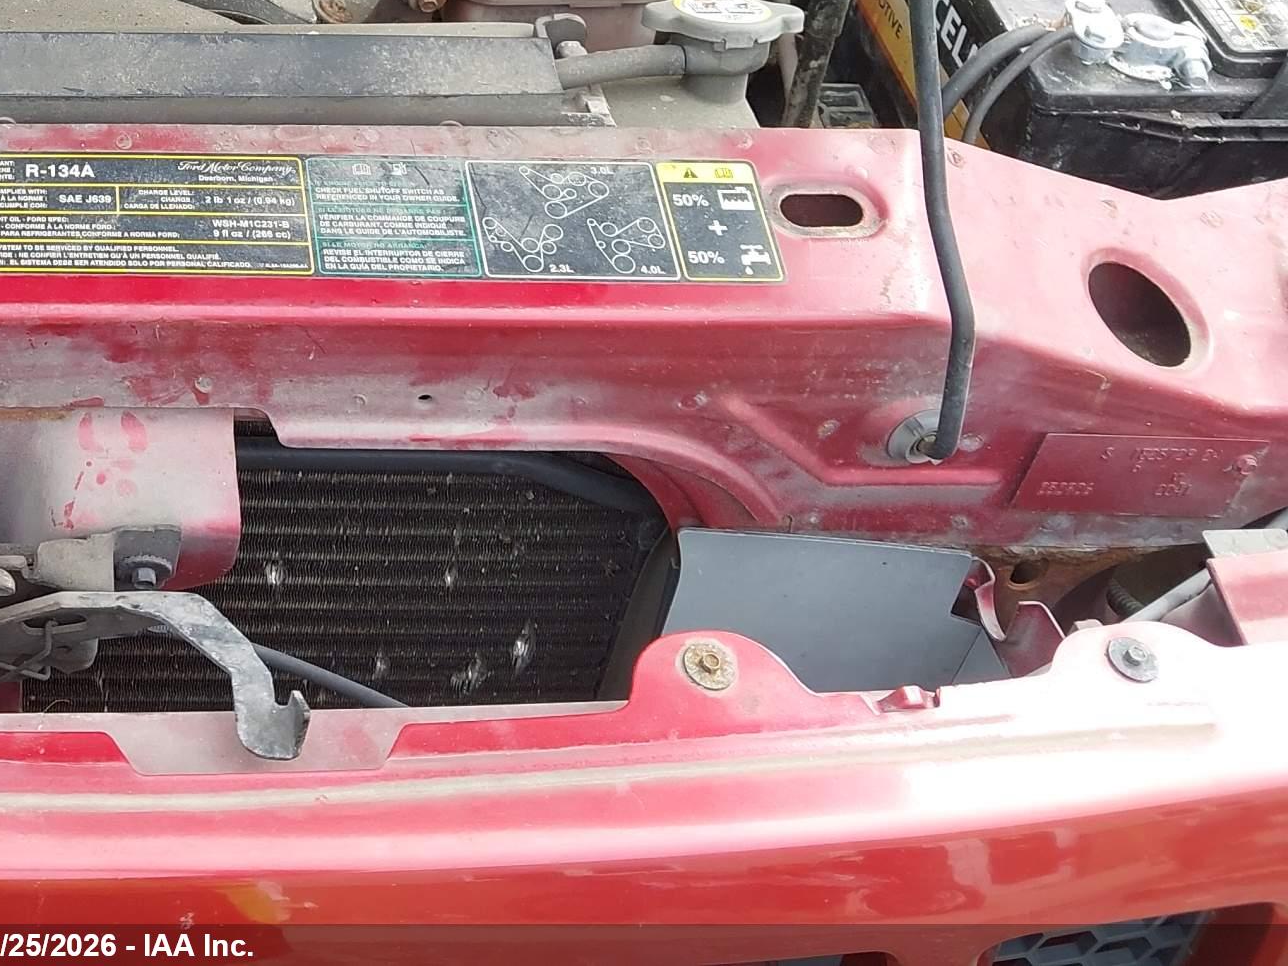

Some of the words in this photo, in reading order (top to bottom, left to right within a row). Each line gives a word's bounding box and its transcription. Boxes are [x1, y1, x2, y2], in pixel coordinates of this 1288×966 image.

[25, 163, 95, 178] R-134A
[59, 194, 82, 203] SAE
[86, 194, 112, 204] J639
[205, 196, 212, 204] 2
[213, 196, 224, 204] lb
[672, 193, 709, 207] 50%
[212, 219, 290, 229] WSH-M1C231-B
[687, 250, 725, 264] 50%
[549, 264, 575, 274] 2.3L
[640, 265, 666, 275] 4.0L
